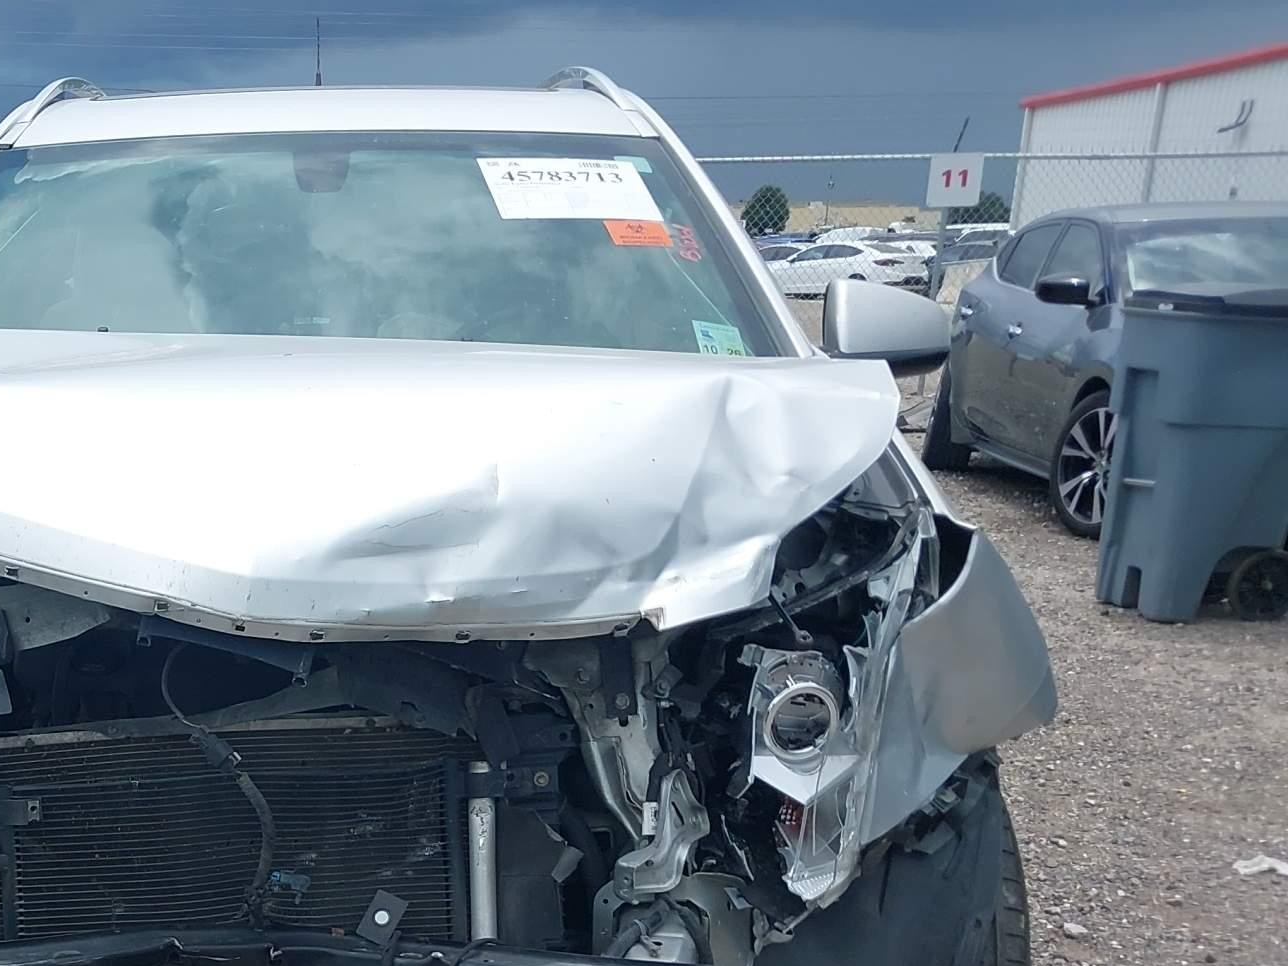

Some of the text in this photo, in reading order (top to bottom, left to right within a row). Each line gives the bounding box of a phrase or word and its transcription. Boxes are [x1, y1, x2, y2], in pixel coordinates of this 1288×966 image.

[500, 170, 624, 184] 45783713
[941, 169, 969, 188] 11
[703, 344, 719, 355] 10
